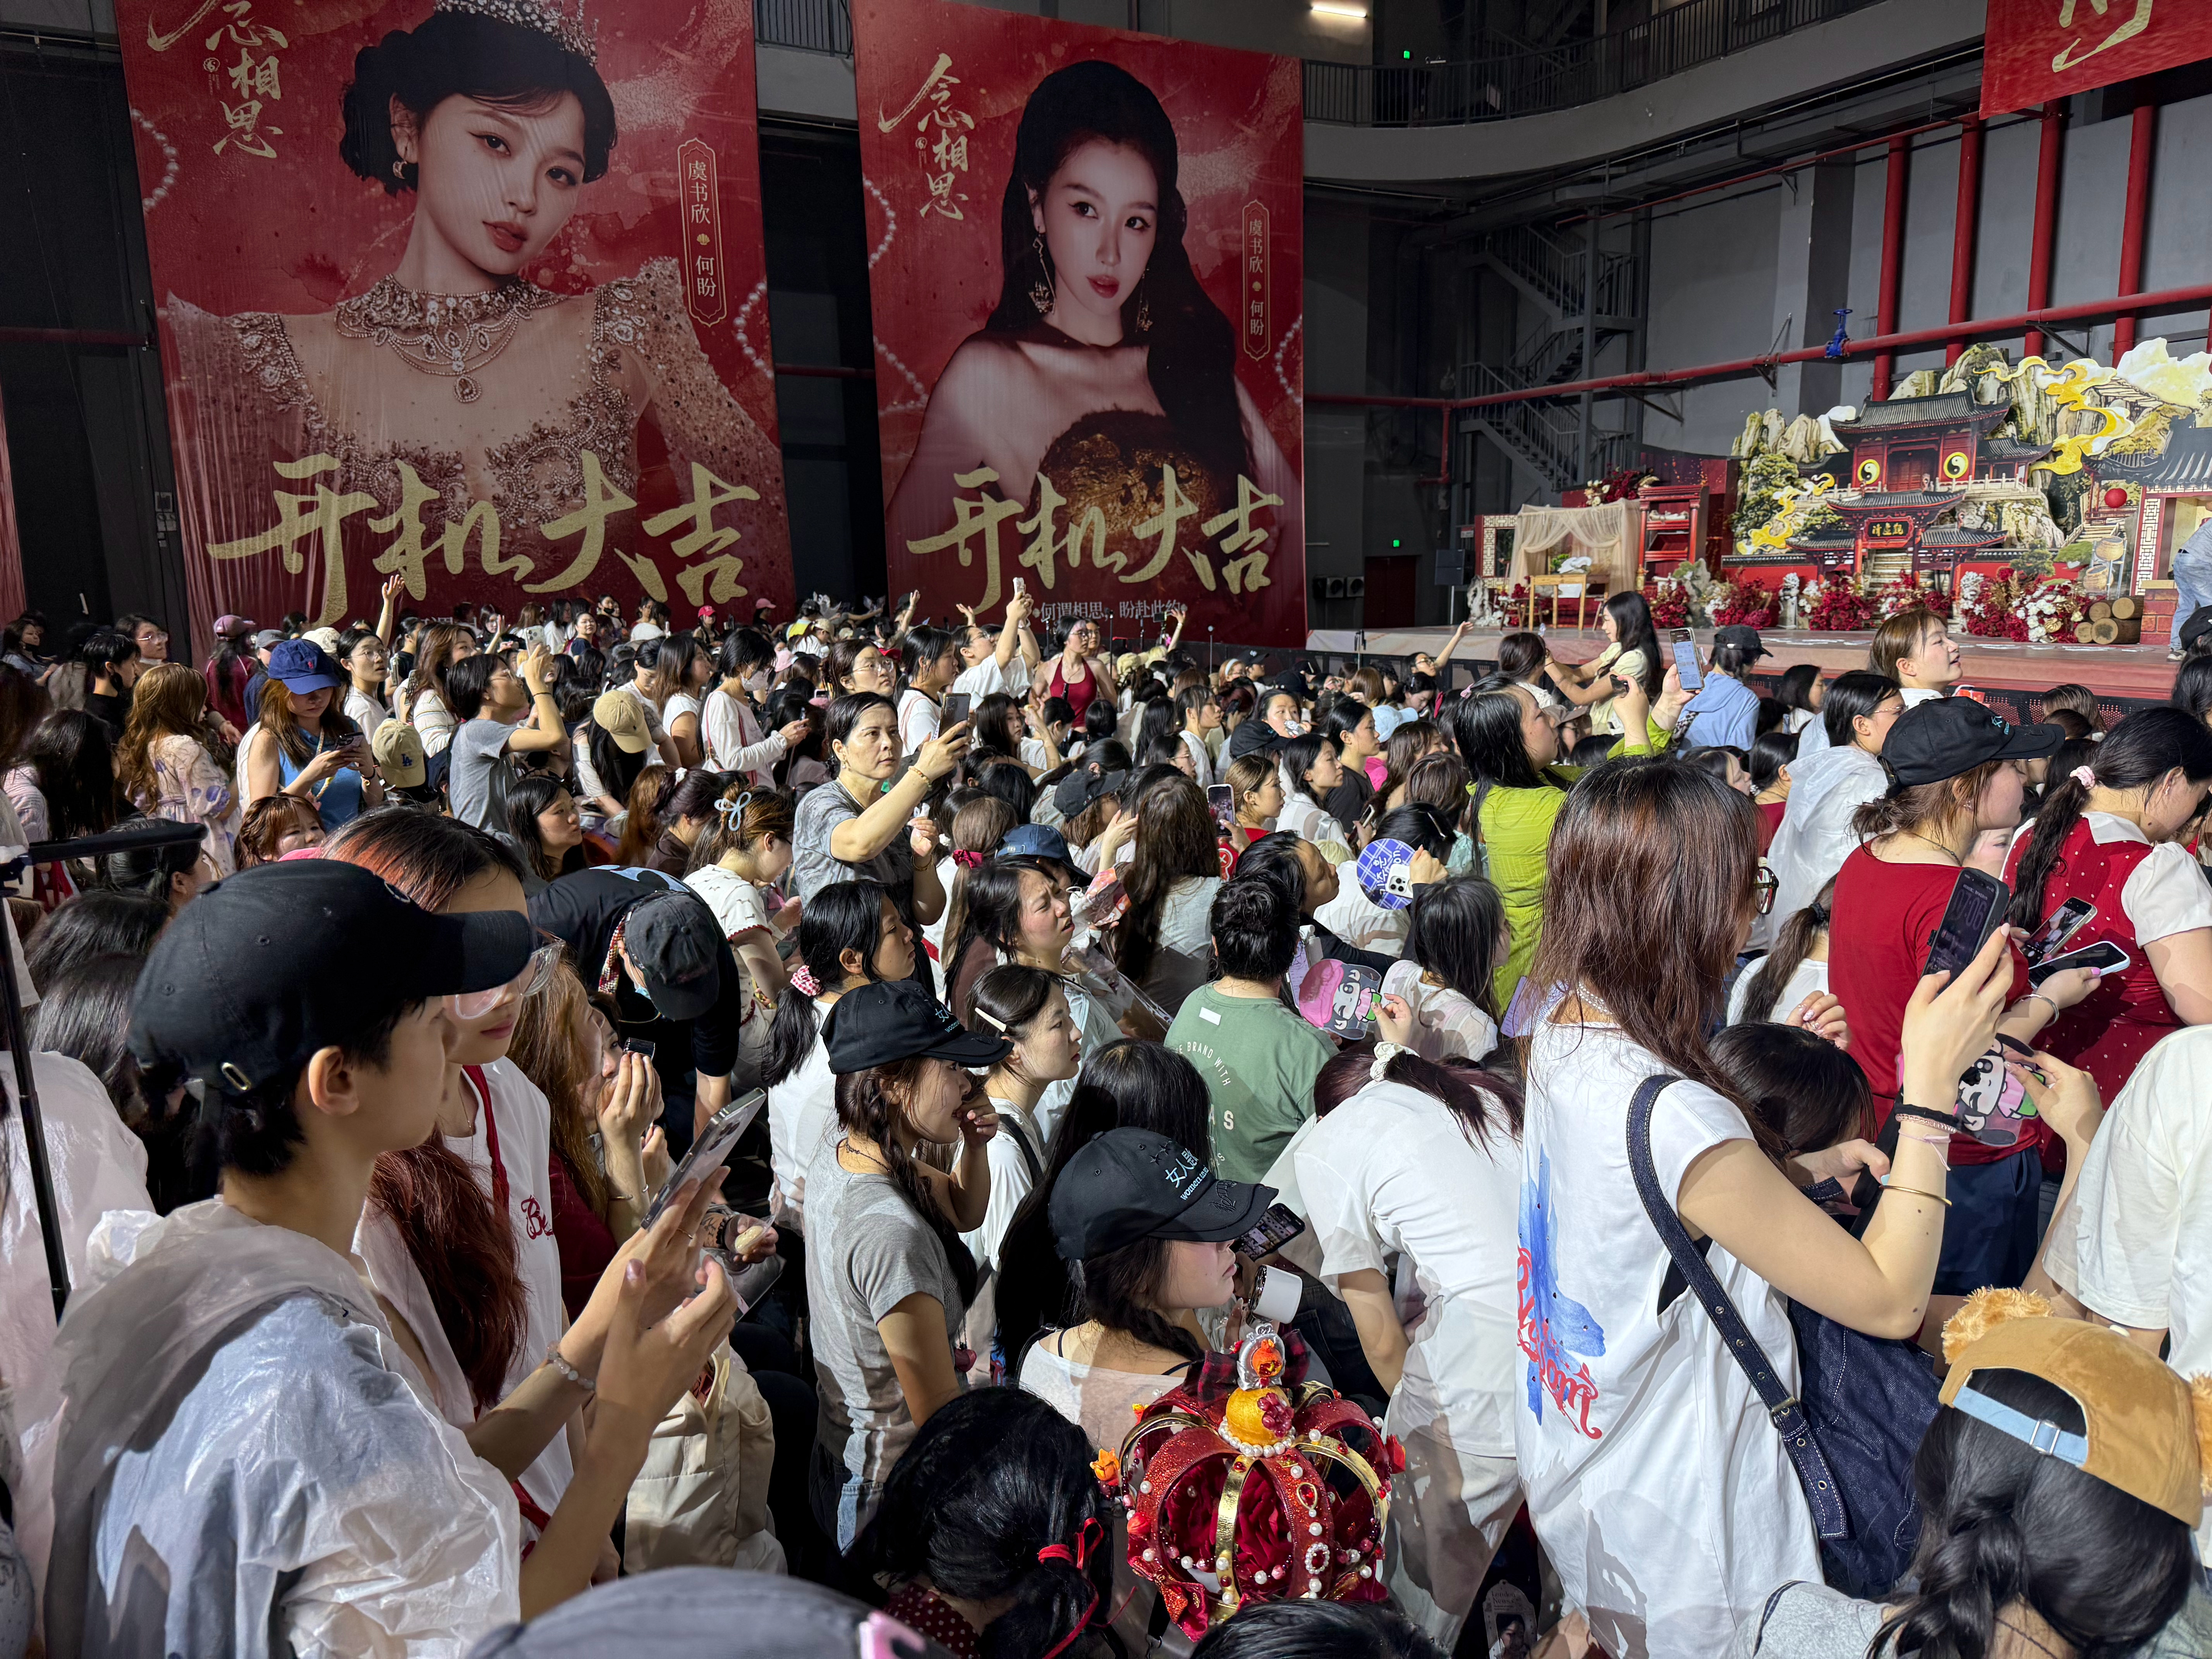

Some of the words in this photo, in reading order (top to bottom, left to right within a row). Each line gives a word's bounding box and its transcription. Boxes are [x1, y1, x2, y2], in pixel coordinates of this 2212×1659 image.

[878, 53, 975, 220] 念相思
[688, 160, 711, 224] 虞书欣
[1249, 218, 1263, 273] 虞书欣
[696, 255, 716, 297] 何盼
[1250, 300, 1264, 336] 何盼
[206, 450, 761, 627] 开机大吉
[907, 464, 1284, 615] 开机大吉
[1393, 850, 1401, 864] on
[1187, 1041, 1213, 1058] BRAND
[1214, 1057, 1231, 1086] WITH
